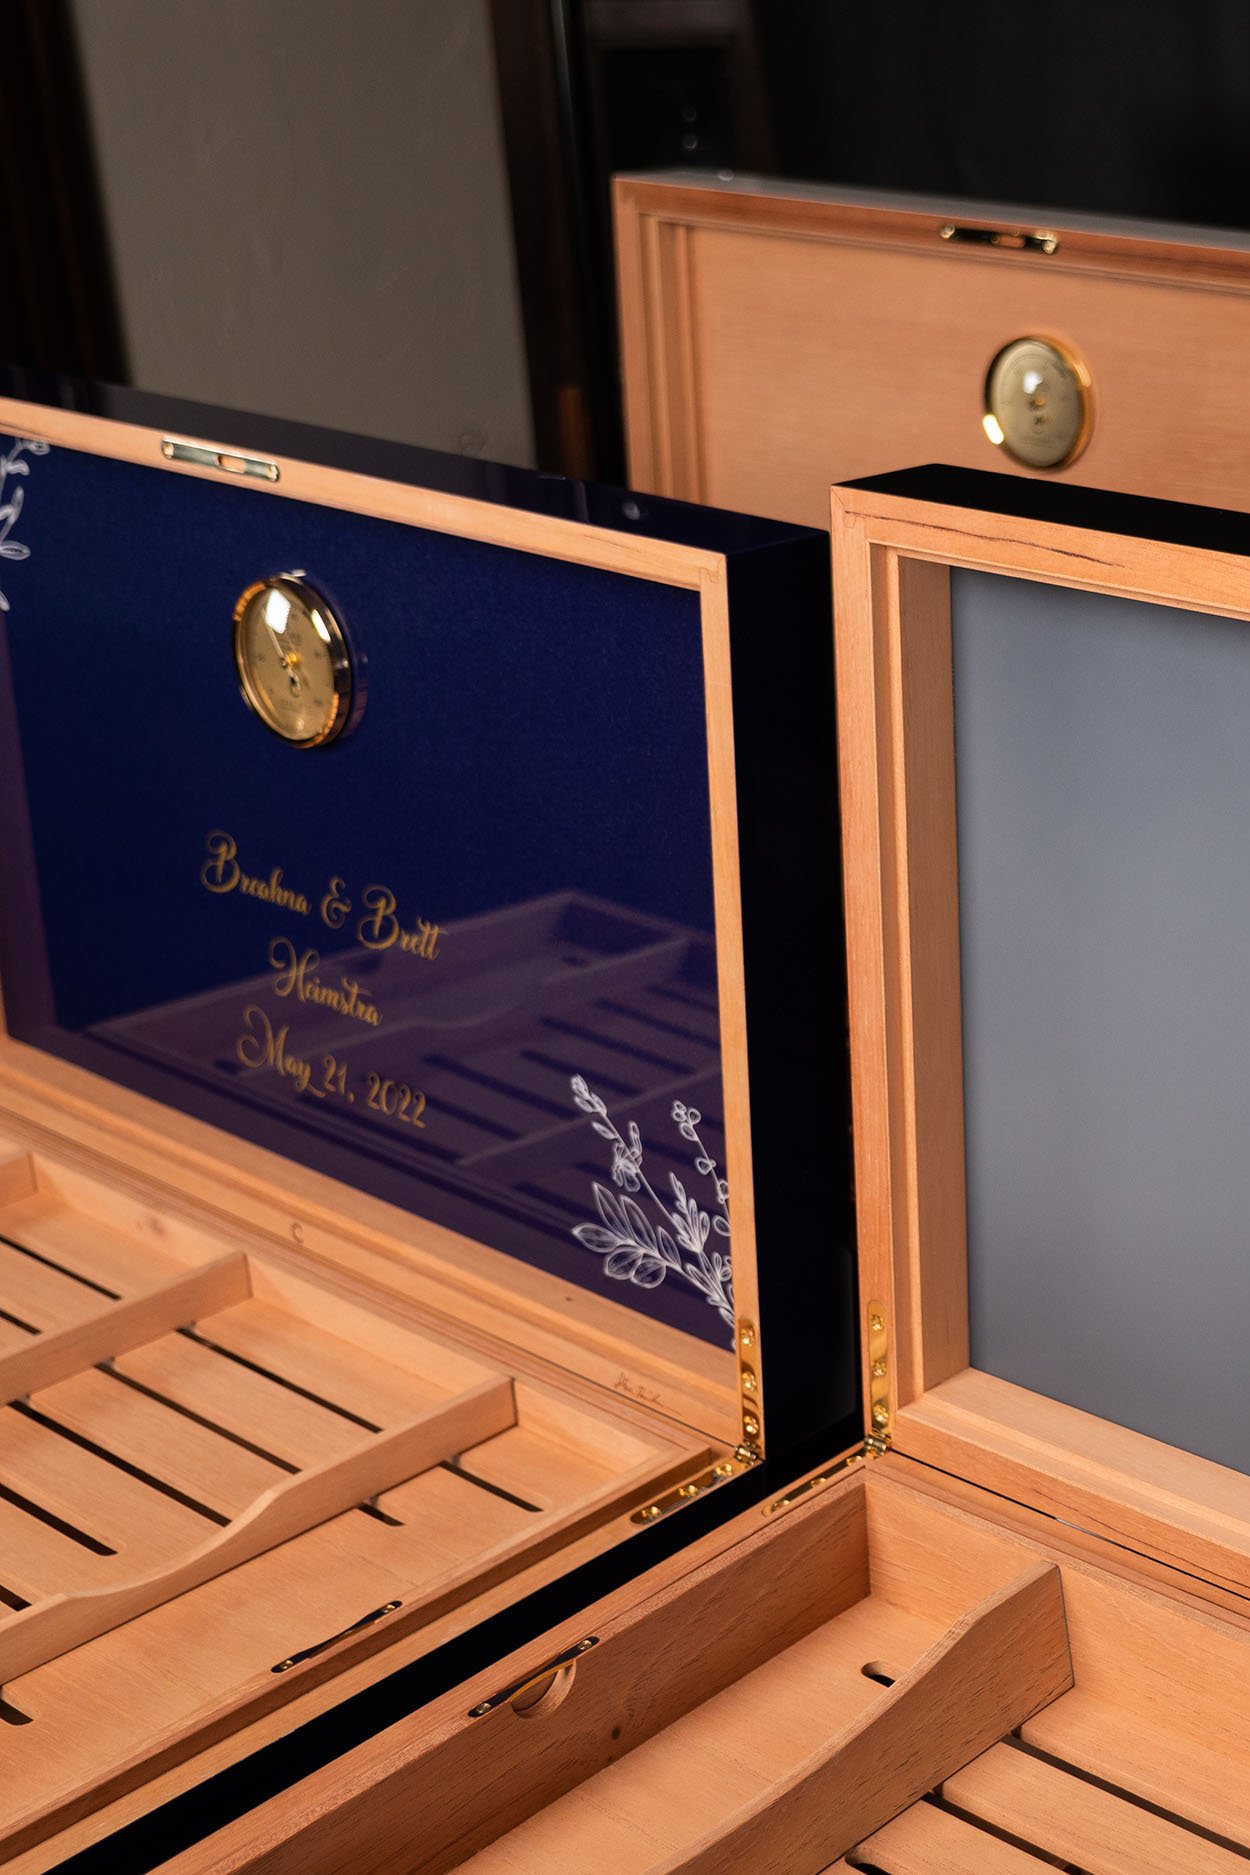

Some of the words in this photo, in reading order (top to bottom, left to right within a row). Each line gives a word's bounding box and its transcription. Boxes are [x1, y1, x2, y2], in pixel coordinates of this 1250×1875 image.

[321, 877, 352, 929] &
[236, 1003, 326, 1099] May
[367, 1071, 427, 1129] 2022
